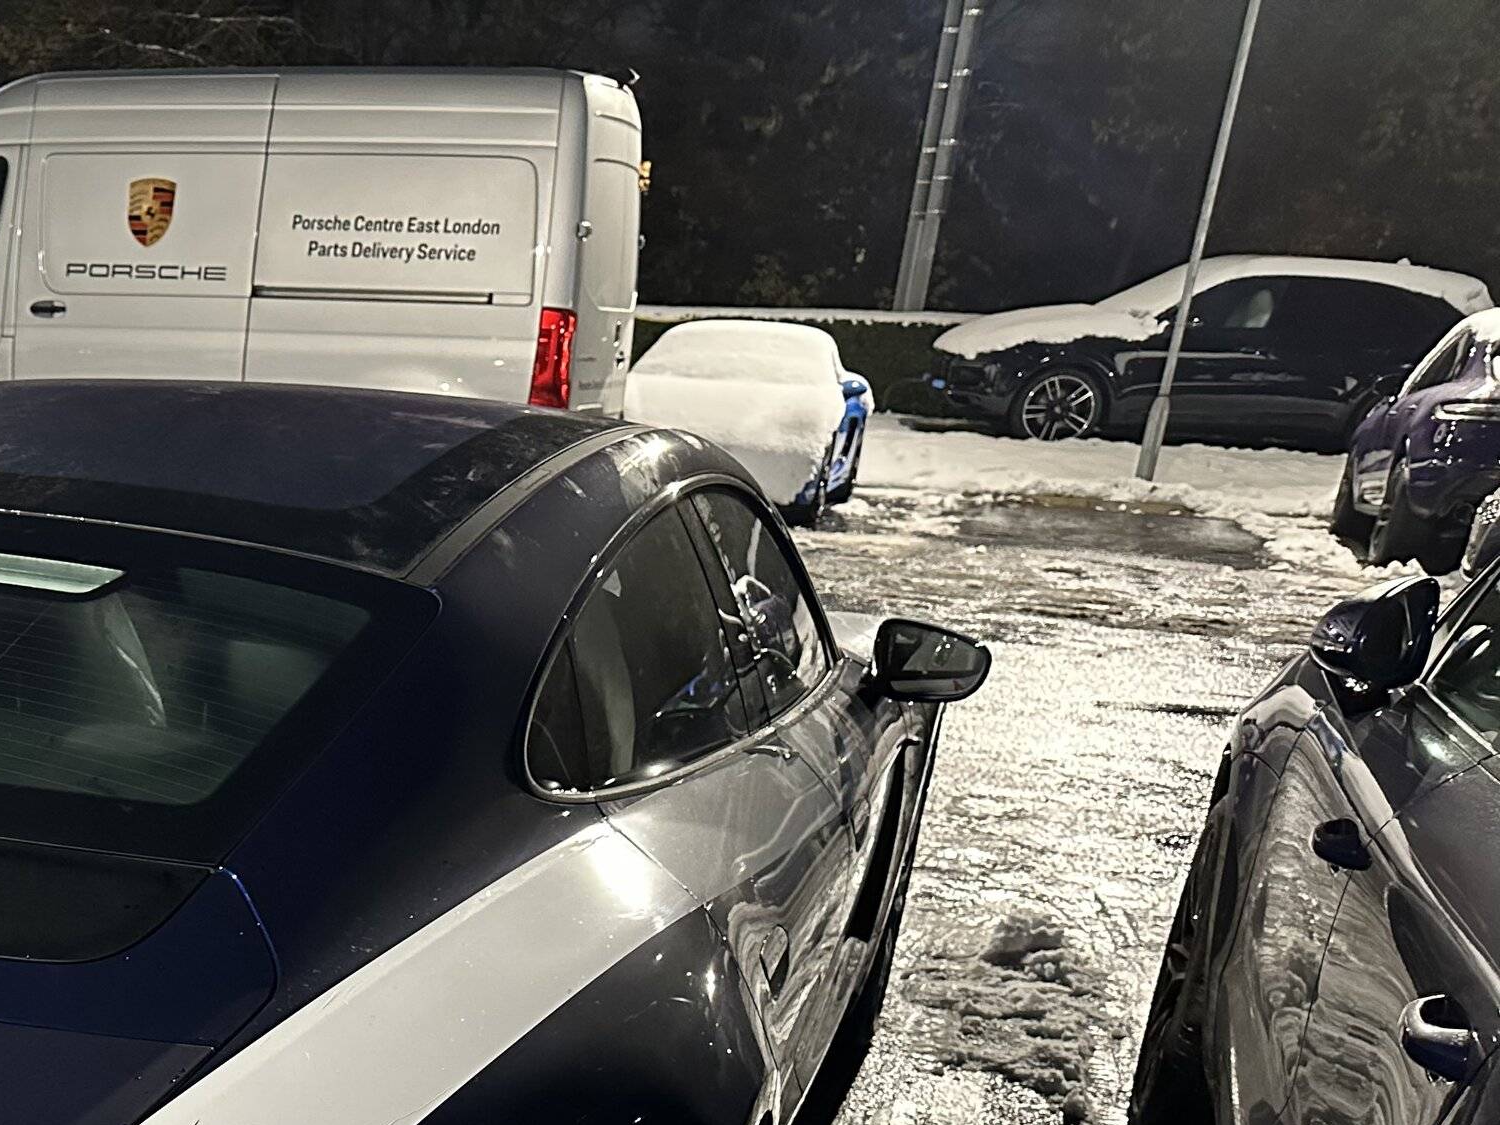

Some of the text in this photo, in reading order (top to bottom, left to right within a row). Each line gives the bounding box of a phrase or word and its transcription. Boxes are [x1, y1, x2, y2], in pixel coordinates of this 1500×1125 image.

[292, 214, 501, 236] Porsche Centre East London
[307, 240, 477, 264] Parts Delivery Service
[66, 263, 227, 281] PORSCHE
